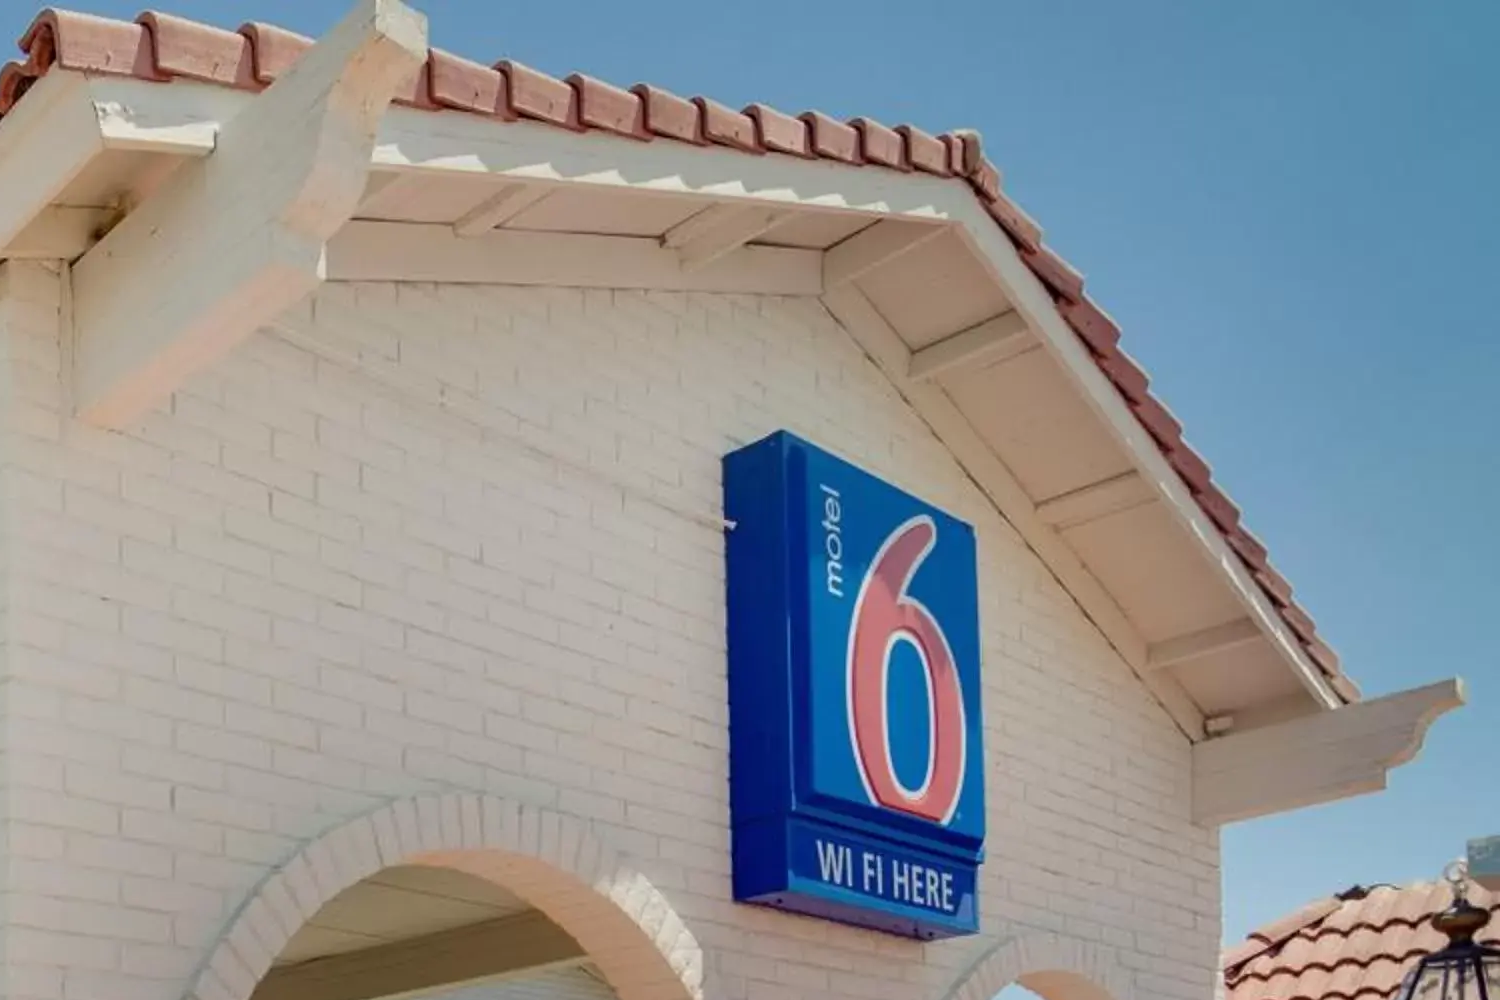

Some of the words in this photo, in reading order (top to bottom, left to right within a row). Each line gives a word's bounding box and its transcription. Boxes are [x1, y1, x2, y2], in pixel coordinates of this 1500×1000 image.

[819, 483, 844, 598] motel
[846, 514, 966, 826] 6
[816, 839, 853, 887] WI
[862, 851, 883, 895] FI
[892, 859, 954, 912] HERE
